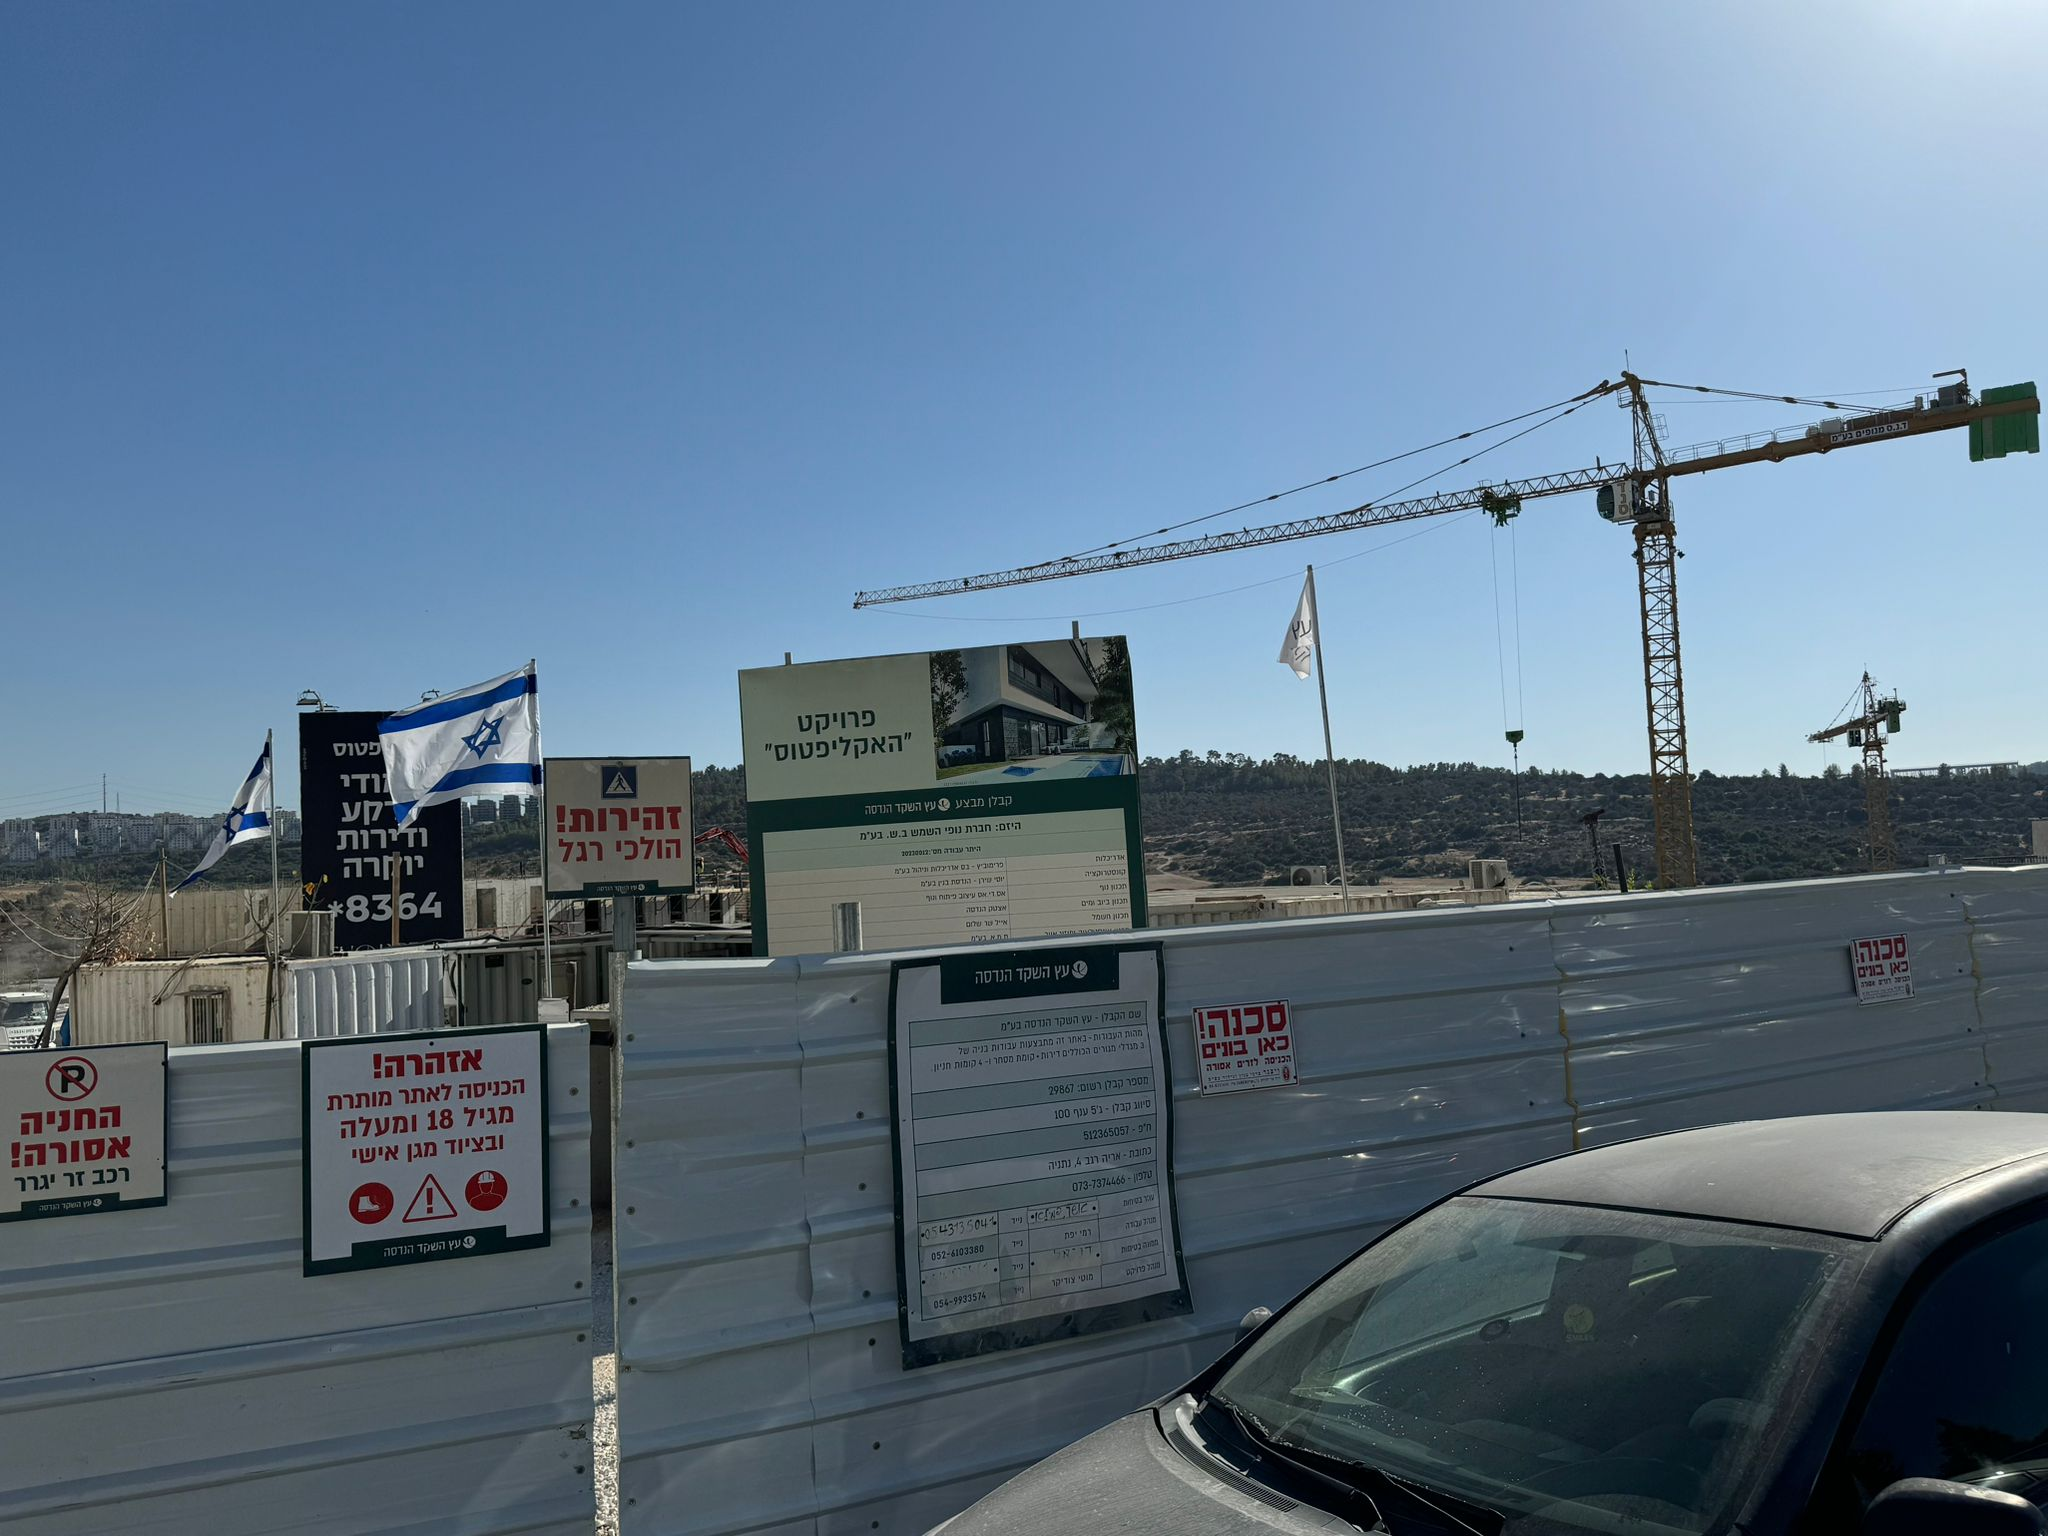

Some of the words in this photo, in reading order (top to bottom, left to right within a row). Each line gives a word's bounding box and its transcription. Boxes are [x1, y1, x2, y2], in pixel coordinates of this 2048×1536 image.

[1831, 432, 1854, 442] בע"מ
[1855, 426, 1885, 438] מנופים
[797, 709, 876, 735] פרויקט
[764, 731, 912, 761] "האקליפטוס"
[895, 802, 922, 814] השקד
[924, 801, 937, 812] עץ
[955, 797, 985, 809] מבצע
[988, 795, 1013, 809] קבלן
[864, 804, 892, 815] הנדסה
[556, 805, 682, 833] זהירות!
[910, 826, 942, 837] השמש
[944, 825, 962, 835] נופי
[964, 823, 992, 834] חברת
[995, 820, 1022, 832] היזם:
[336, 827, 428, 851] ודירות
[859, 830, 883, 841] בע"מ
[558, 838, 603, 863] רגל
[616, 836, 681, 861] הולכי
[1095, 854, 1125, 862] אדריכלות
[975, 968, 1012, 985] הנדסה
[1016, 965, 1050, 982] השקד
[1054, 964, 1070, 980] עץ
[1081, 1014, 1093, 1025] עץ
[1101, 1011, 1126, 1023] הקבלן
[1128, 1010, 1142, 1019] שם
[1000, 1020, 1022, 1032] בע"מ
[1024, 1017, 1052, 1029] הנדסה
[1054, 1015, 1079, 1027] השקד
[1198, 1004, 1287, 1040] סכנה!
[1068, 1034, 1087, 1043] באתר
[1093, 1031, 1123, 1041] העבודות
[1125, 1029, 1143, 1038] מהות
[991, 1042, 1017, 1052] עבודות
[1019, 1038, 1053, 1049] מתבצעות
[1056, 1037, 1065, 1045] זה
[1257, 1035, 1290, 1057] כאן
[958, 1047, 969, 1055] של
[972, 1045, 988, 1055] בניה
[1062, 1047, 1091, 1057] הכוללים
[1201, 1040, 1248, 1059] בונים
[373, 1048, 483, 1080] אזהרה!
[954, 1059, 977, 1070] קומות
[994, 1055, 1014, 1064] מסחר
[1236, 1057, 1259, 1068] לזרים
[1264, 1055, 1292, 1065] הכניסה
[1206, 1061, 1231, 1072] אסורה
[1077, 1081, 1102, 1093] רשום:
[1104, 1079, 1124, 1091] קבלן
[1126, 1076, 1149, 1087] מספר
[399, 1083, 452, 1105] לאתר
[458, 1078, 525, 1100] הכניסה
[1048, 1083, 1075, 1096] 29867
[326, 1090, 392, 1111] מותרת
[1054, 1108, 1071, 1120] 100
[1073, 1107, 1089, 1119] ענף
[1112, 1102, 1132, 1114] קבלן
[20, 1105, 121, 1136] החניה
[427, 1108, 454, 1131] 18
[463, 1105, 514, 1127] מגיל
[340, 1114, 417, 1139] ומעלה
[1138, 1122, 1152, 1133] ח"פ
[1083, 1125, 1130, 1141] 512365057
[445, 1134, 504, 1155] ובציוד
[11, 1135, 131, 1168] אסורה!
[351, 1144, 399, 1164] אישי
[407, 1141, 437, 1163] מגן
[1101, 1152, 1121, 1163] אריה
[1129, 1146, 1152, 1158] כתובת
[1048, 1159, 1072, 1171] נתניה
[63, 1170, 85, 1187] זר
[92, 1167, 130, 1185] רכב
[1133, 1170, 1153, 1184] טלפון
[14, 1173, 56, 1192] יגרר
[1072, 1174, 1126, 1192] 073-7374466
[39, 1203, 60, 1212] הנדסה
[61, 1201, 81, 1210] השקד
[82, 1200, 92, 1209] עץ
[383, 1244, 414, 1258] הנדסה
[416, 1240, 446, 1254] השקד
[449, 1240, 461, 1251] עץ
[931, 1244, 985, 1261] 052-6103380
[933, 1291, 986, 1310] 054-9933574
